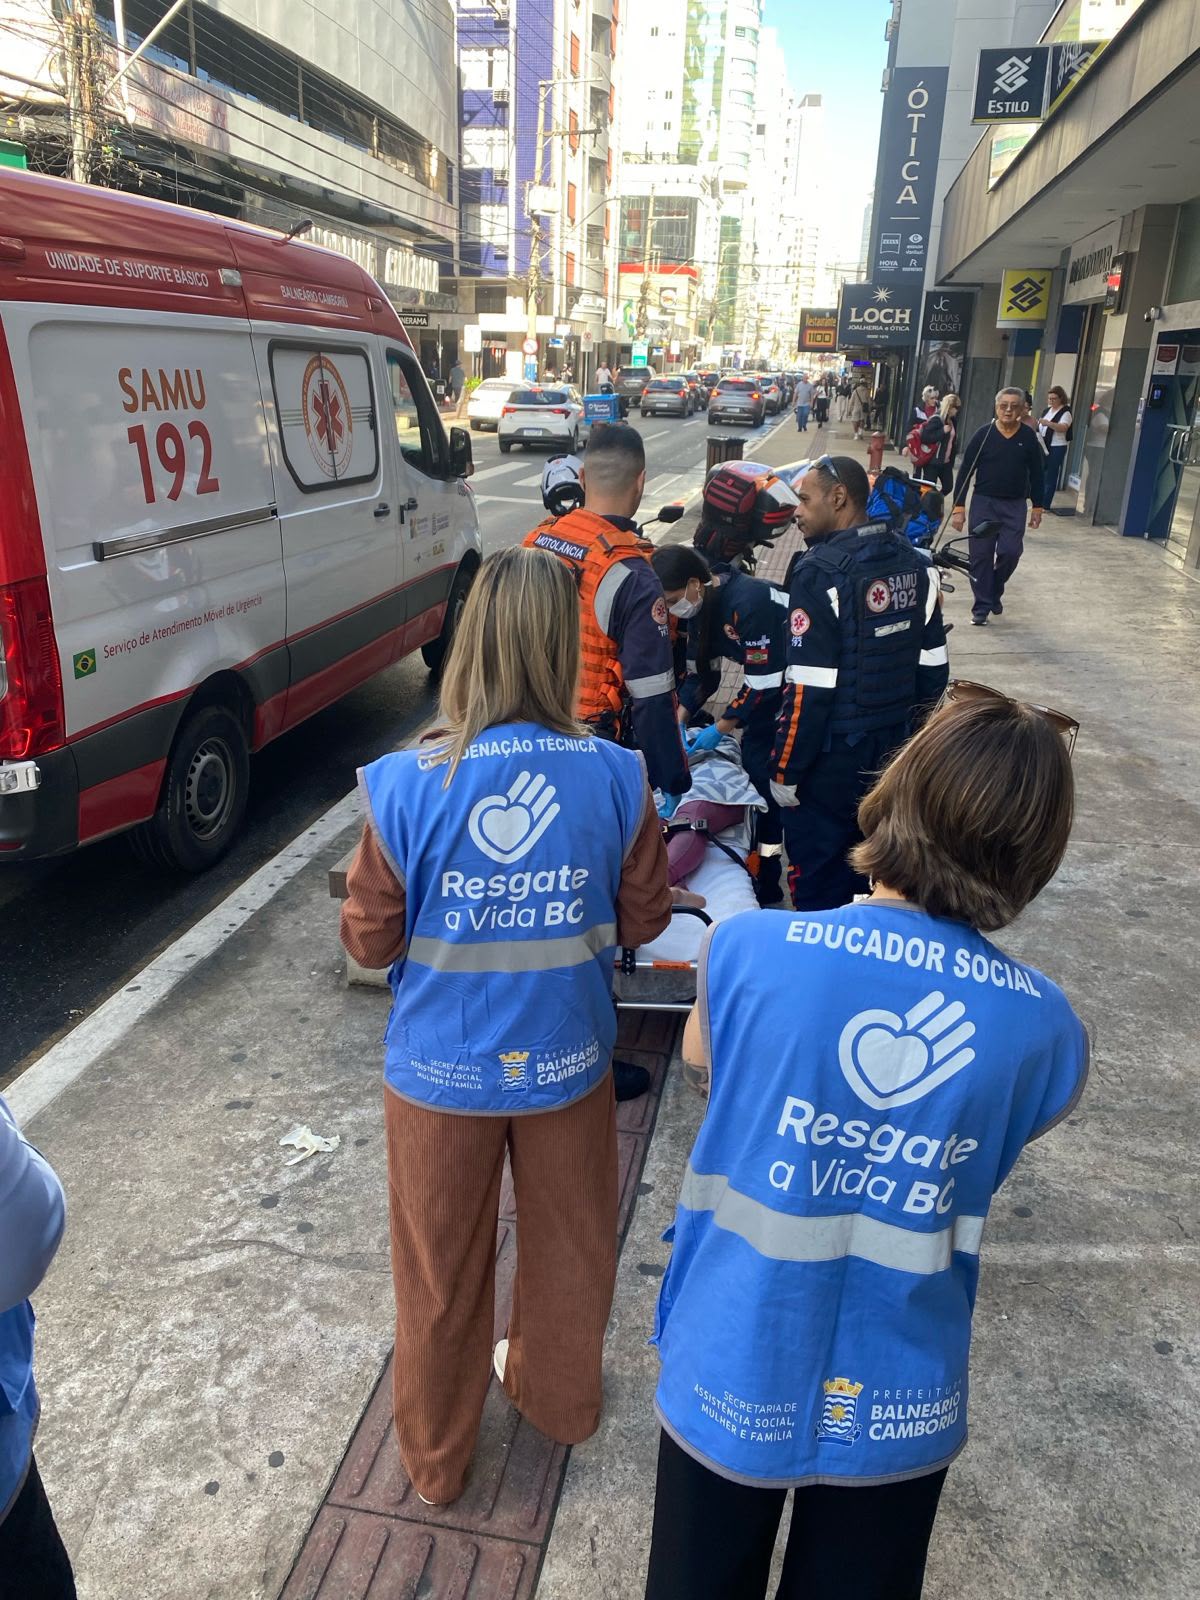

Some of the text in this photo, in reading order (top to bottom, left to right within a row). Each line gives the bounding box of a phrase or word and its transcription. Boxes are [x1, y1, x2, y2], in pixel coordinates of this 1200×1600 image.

[987, 100, 1030, 114] ESTILO
[896, 81, 929, 204] ÓTICA
[45, 250, 209, 288] UNIDADE DE SUPORTE BÁSICO
[280, 285, 318, 303] BALNEÁRIO
[400, 316, 428, 326] NERAMA
[849, 307, 912, 324] LOCH
[929, 322, 962, 332] CLOSET
[118, 367, 206, 413] SAMU
[127, 420, 220, 504] 192
[534, 534, 584, 560] MOTOLÂNCIA
[888, 573, 917, 592] SAMU
[891, 588, 917, 611] 192
[103, 593, 263, 659] Serviço de Atendimento Móvel de Urgência
[536, 735, 598, 753] TÉCNICA
[441, 865, 589, 902] Resgate
[445, 897, 584, 931] a Vida BC
[785, 920, 1042, 998] EDUCADOR SOCIAL
[430, 1059, 471, 1072] SECRETARIA
[452, 1072, 483, 1082] SOCIAL,
[417, 1071, 482, 1090] MULHER E FAMÍLIA
[776, 1095, 978, 1171] Resgate
[768, 1158, 955, 1214] a Vida BC
[693, 1383, 795, 1428] ASSISTÊNCIA SOCIAL,
[723, 1391, 798, 1414] SECRETARIA DE
[701, 1402, 793, 1442] MULHER E FAMÍLIA
